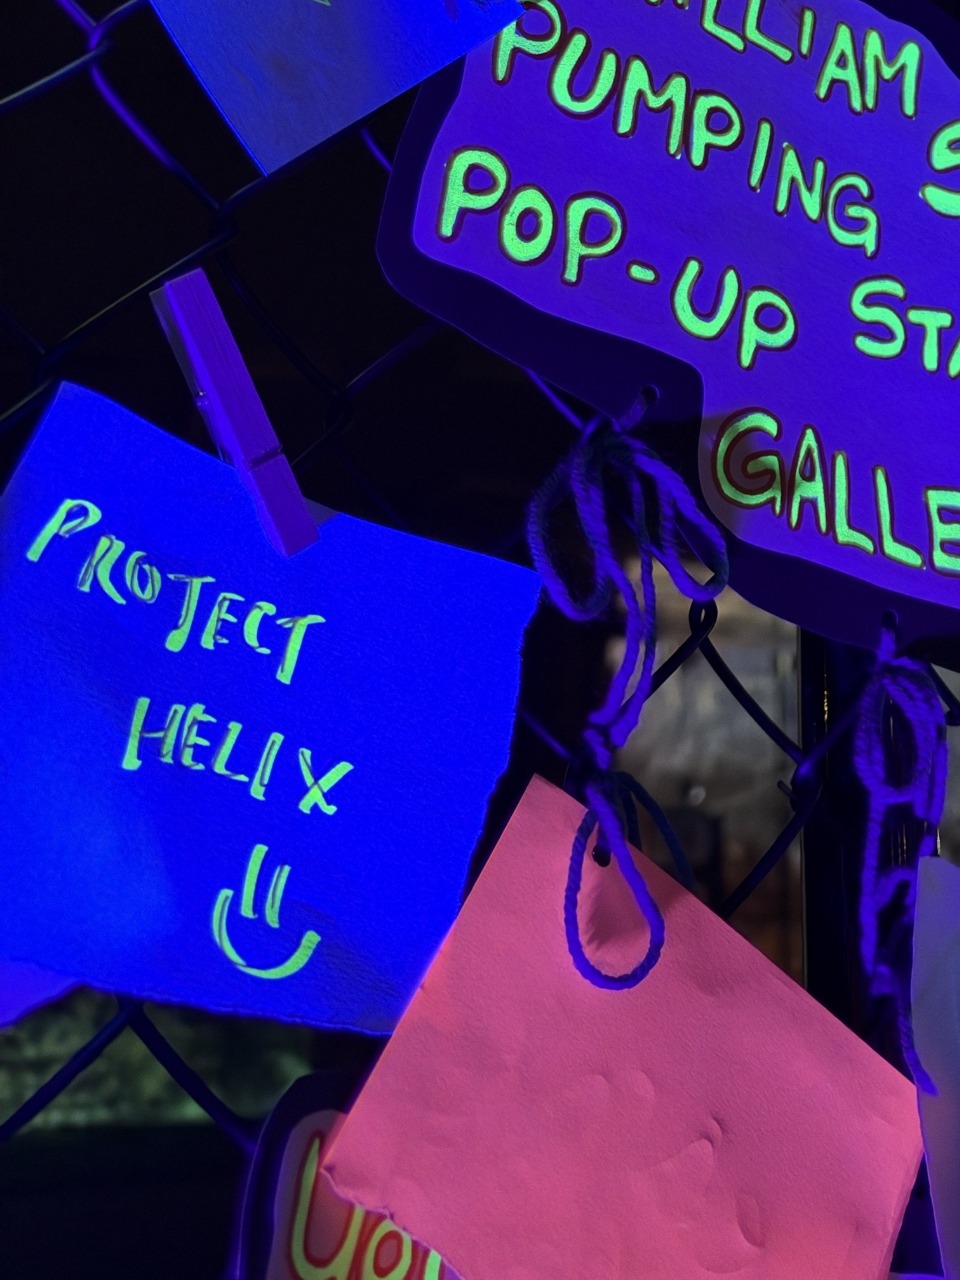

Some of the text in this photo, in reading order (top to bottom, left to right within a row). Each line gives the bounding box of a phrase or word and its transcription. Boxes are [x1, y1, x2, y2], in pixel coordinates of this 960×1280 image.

[435, 147, 799, 371] POP-UP
[26, 498, 327, 685] PROJECT
[121, 696, 355, 816] HELIX
